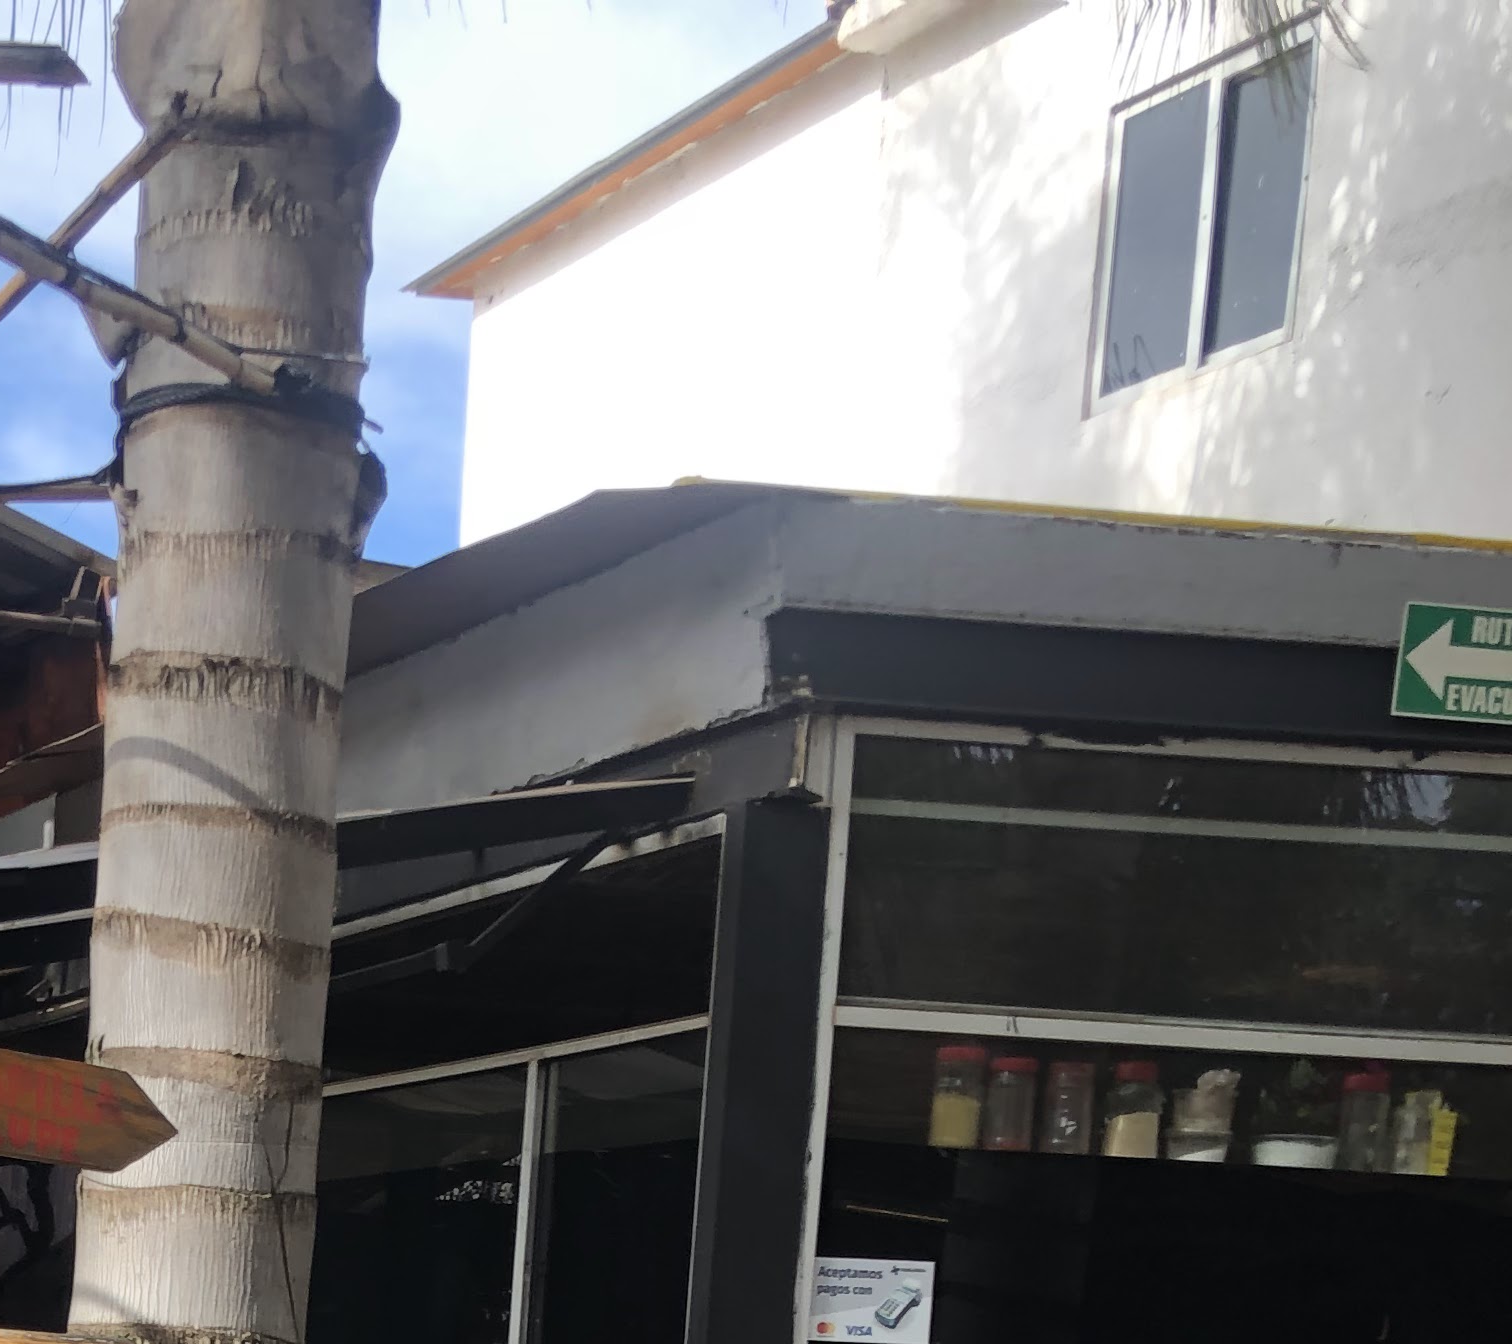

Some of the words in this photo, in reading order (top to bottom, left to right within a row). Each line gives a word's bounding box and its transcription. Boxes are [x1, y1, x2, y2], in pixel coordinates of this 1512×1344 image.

[817, 1266, 883, 1280] Aceptamos
[816, 1285, 850, 1297] pagos
[846, 1325, 873, 1337] VISA
